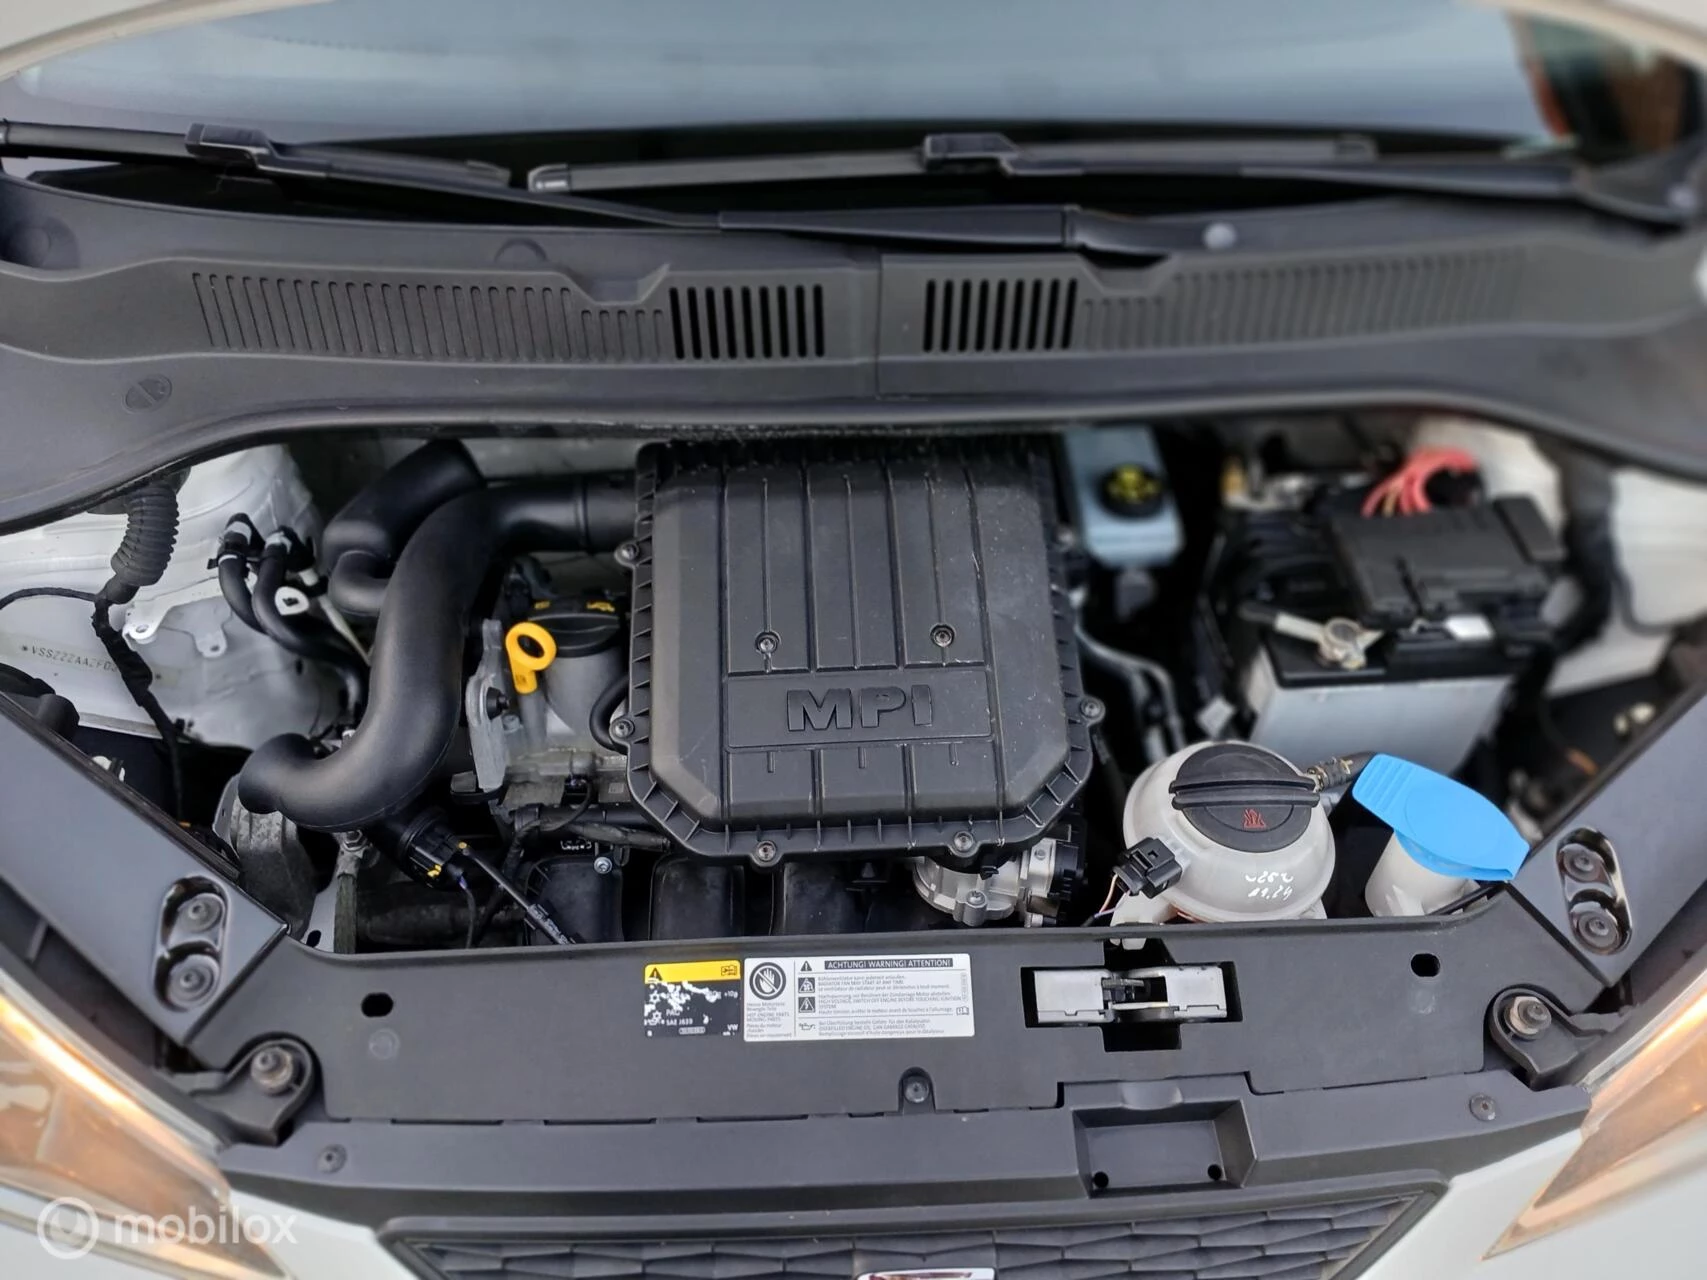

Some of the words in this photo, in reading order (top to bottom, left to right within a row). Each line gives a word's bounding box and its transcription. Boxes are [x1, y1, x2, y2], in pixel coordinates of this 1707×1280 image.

[787, 685, 932, 731] MPI
[827, 961, 866, 969] ACHTUNG!
[868, 960, 907, 968] WARNING!
[908, 959, 951, 967] ATTENTION!
[727, 1023, 739, 1031] VW
